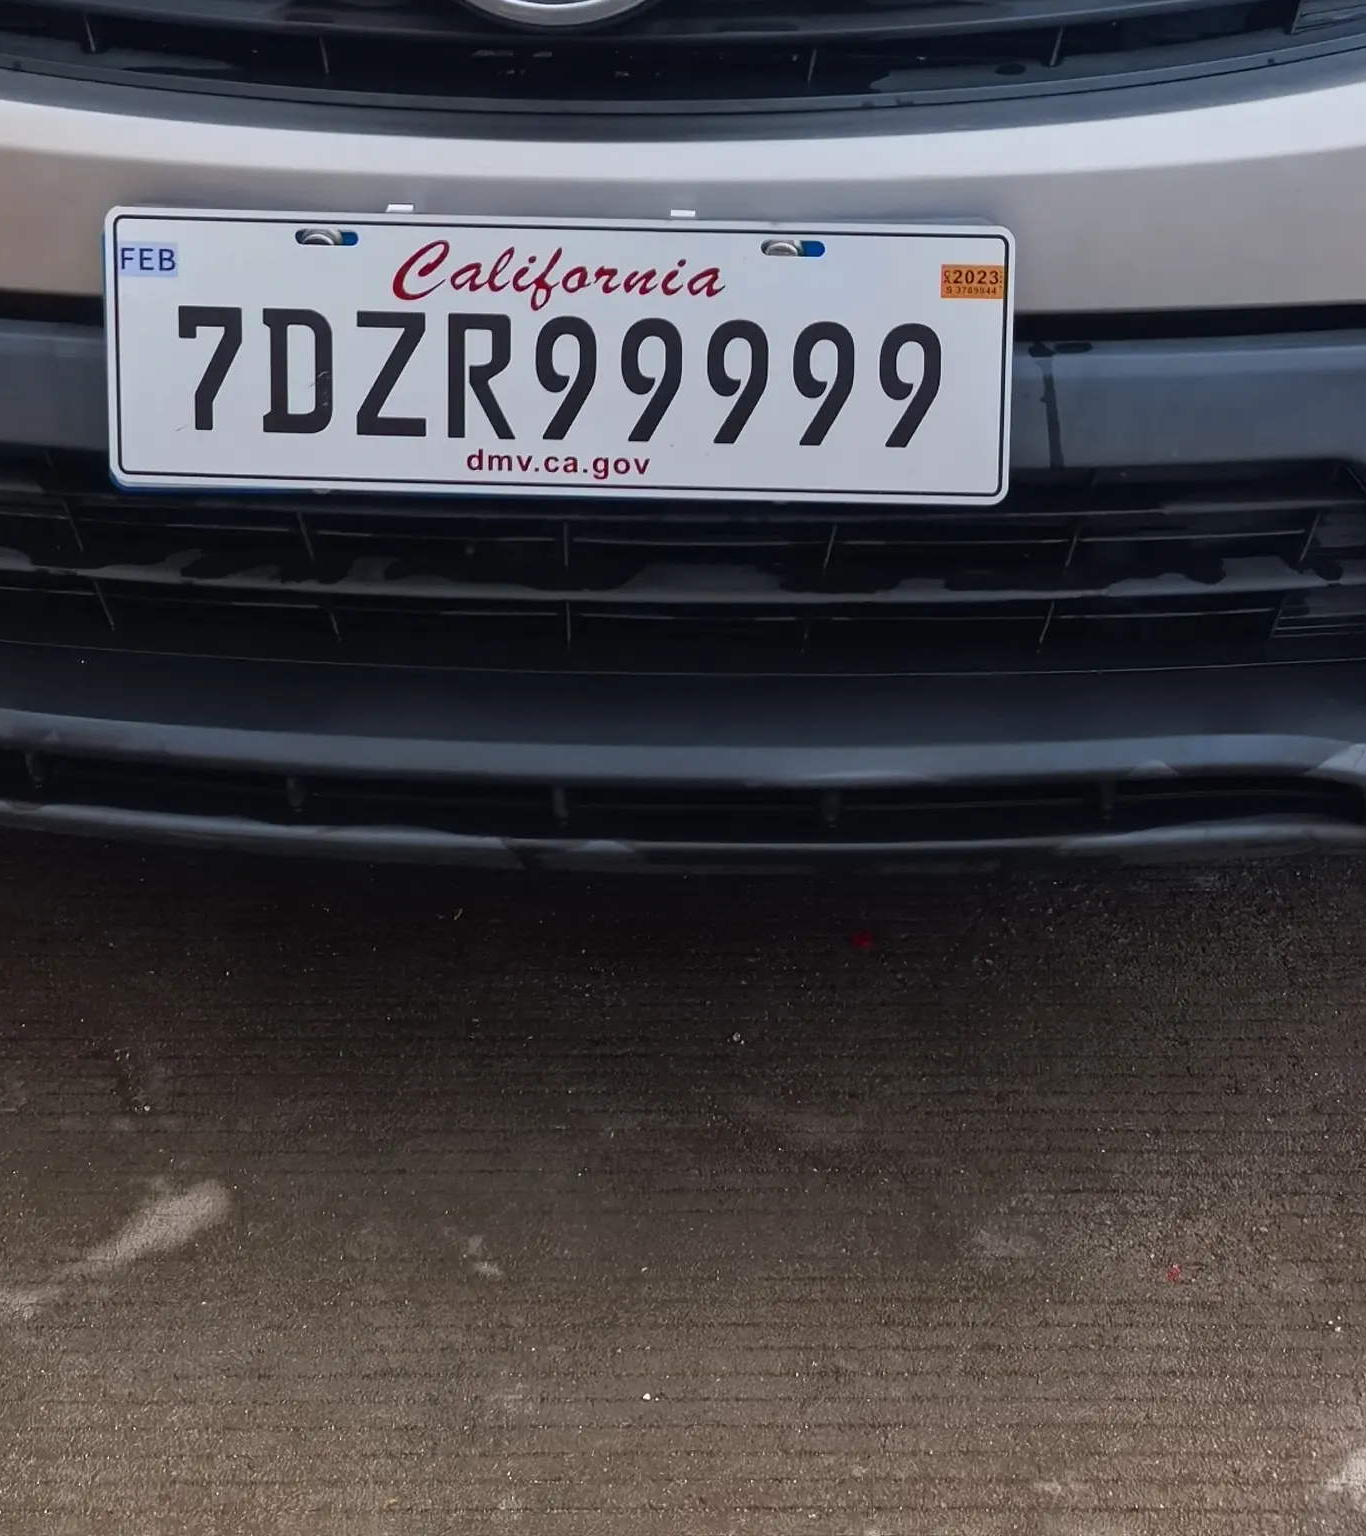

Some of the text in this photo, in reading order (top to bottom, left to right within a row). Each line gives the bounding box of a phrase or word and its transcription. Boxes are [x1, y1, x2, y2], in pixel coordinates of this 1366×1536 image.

[120, 247, 176, 271] FEB
[392, 240, 726, 311] California
[953, 270, 999, 284] 2023
[178, 304, 943, 449] 7DZR99999
[466, 450, 651, 480] dmv.ca.gov
